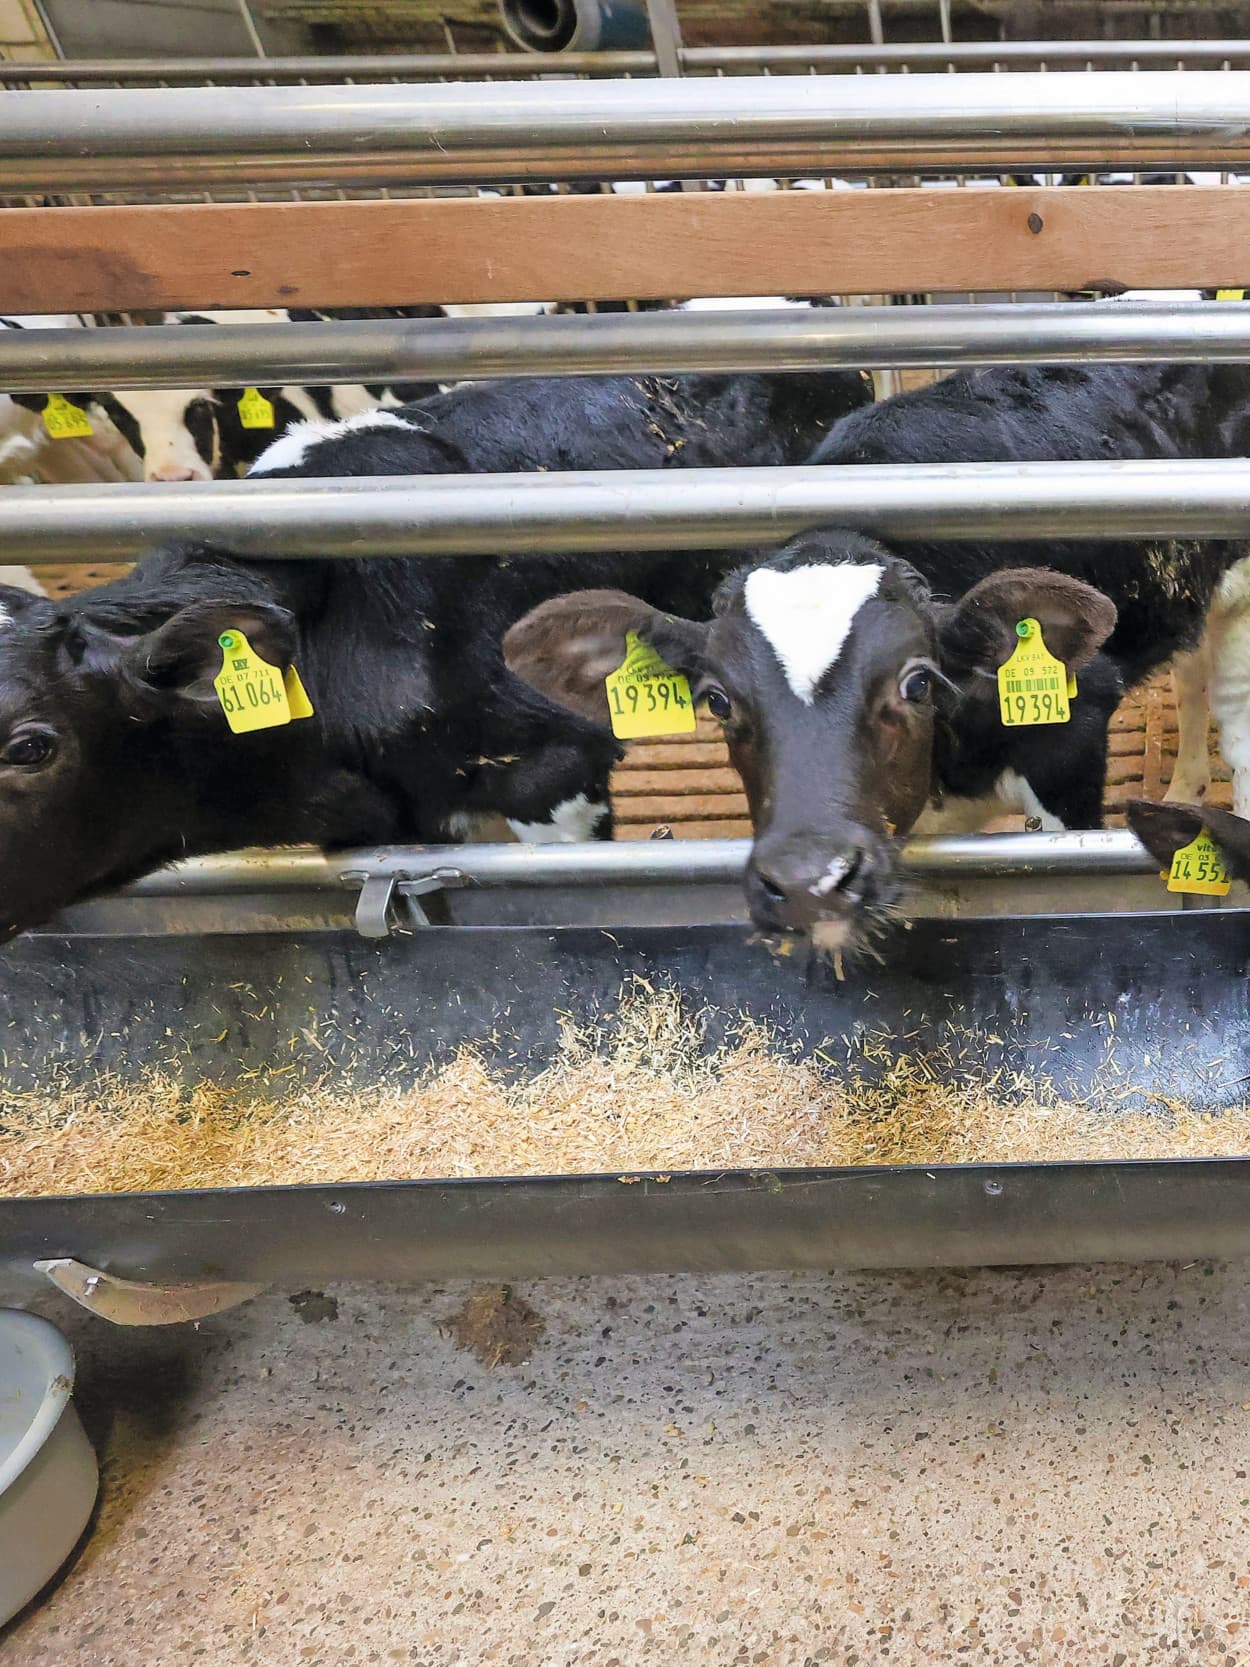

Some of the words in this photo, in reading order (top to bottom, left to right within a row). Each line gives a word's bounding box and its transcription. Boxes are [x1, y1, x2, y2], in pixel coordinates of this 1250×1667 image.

[1005, 669, 1016, 678] DE
[1023, 667, 1034, 676] 09
[1042, 665, 1058, 675] 572
